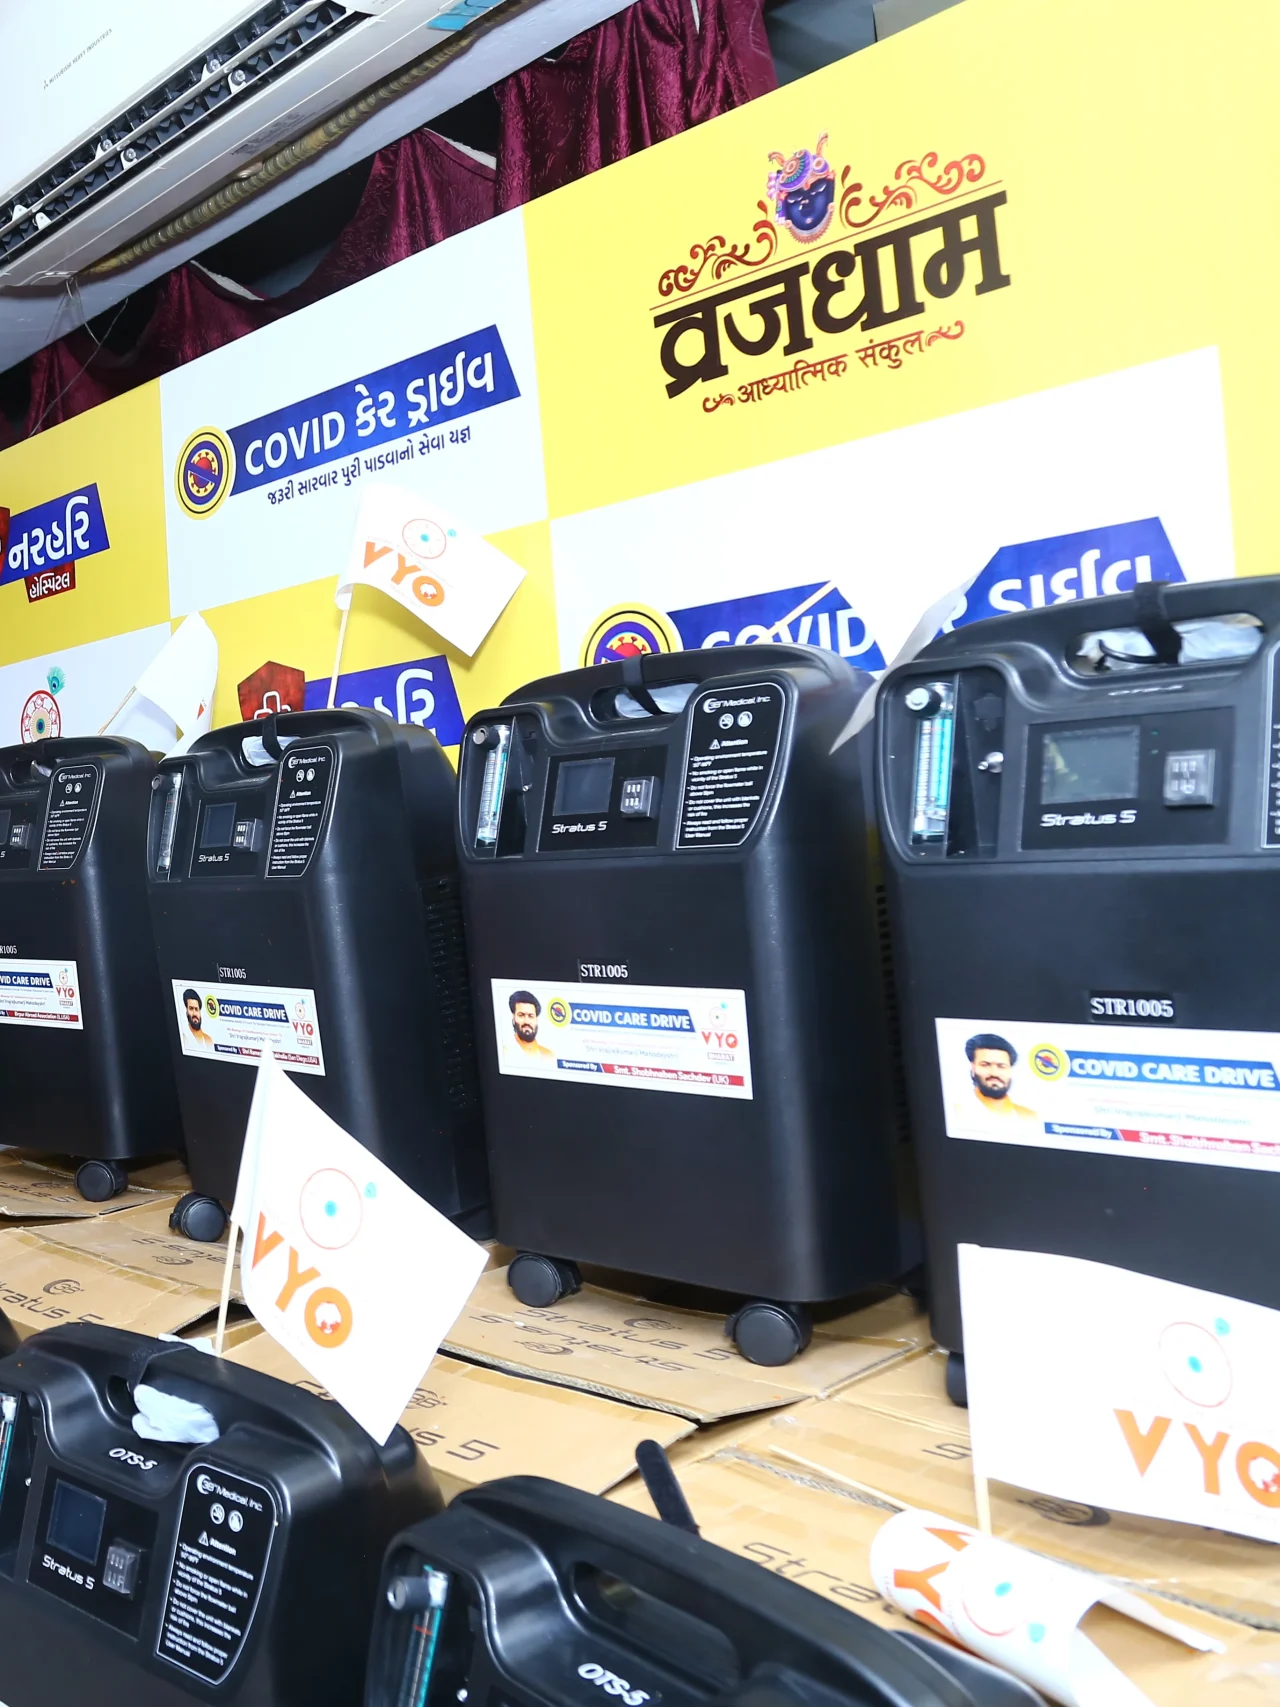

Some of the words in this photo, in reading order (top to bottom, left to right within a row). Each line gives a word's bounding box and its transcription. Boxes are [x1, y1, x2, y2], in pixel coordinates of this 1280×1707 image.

[654, 190, 1012, 399] व्रजधाम
[737, 354, 848, 404] आध्यात्मिक
[858, 329, 925, 369] संकुल
[244, 411, 346, 476] COVID
[354, 384, 397, 438] કેર
[406, 351, 495, 428] ડ્રાઈવ
[297, 470, 338, 496] સારવાર
[418, 433, 445, 456] સેવા
[8, 495, 90, 571] નરહરિ
[29, 571, 70, 599] હોસ્પિટલ
[363, 541, 445, 607] VYO
[721, 739, 748, 747] Attention
[551, 822, 596, 834] Stratus
[1040, 811, 1116, 827] Stratus
[198, 854, 223, 862] Stratus
[12, 976, 29, 986] CARE
[31, 977, 51, 987] DRIVE
[219, 967, 247, 979] STR1005
[580, 965, 628, 979] STR1005
[56, 986, 75, 998] VYO
[220, 1003, 242, 1016] COVID
[243, 1006, 262, 1018] CARE
[264, 1007, 287, 1020] DRIVE
[573, 1009, 612, 1024] COVID
[614, 1012, 648, 1026] CARE
[651, 1014, 690, 1029] DRIVE
[1090, 997, 1174, 1018] STR1005
[292, 1021, 314, 1036] VYO
[701, 1031, 739, 1049] VYO
[562, 1061, 589, 1070] Sponsored
[614, 1066, 630, 1075] Smt.
[678, 1072, 711, 1083] Sachdev
[712, 1075, 730, 1085] (UK)
[1071, 1058, 1138, 1079] COVID
[1141, 1062, 1201, 1083] CARE
[1204, 1066, 1276, 1089] DRIVE
[251, 1211, 353, 1349] VYO
[514, 1308, 690, 1351] Stratus
[108, 1447, 158, 1470] OTS-5
[1113, 1407, 1280, 1509] VYO
[210, 1537, 237, 1556] Attention
[42, 1555, 84, 1585] Stratus
[743, 1542, 883, 1604] Stra
[577, 1662, 651, 1707] OTS-5
